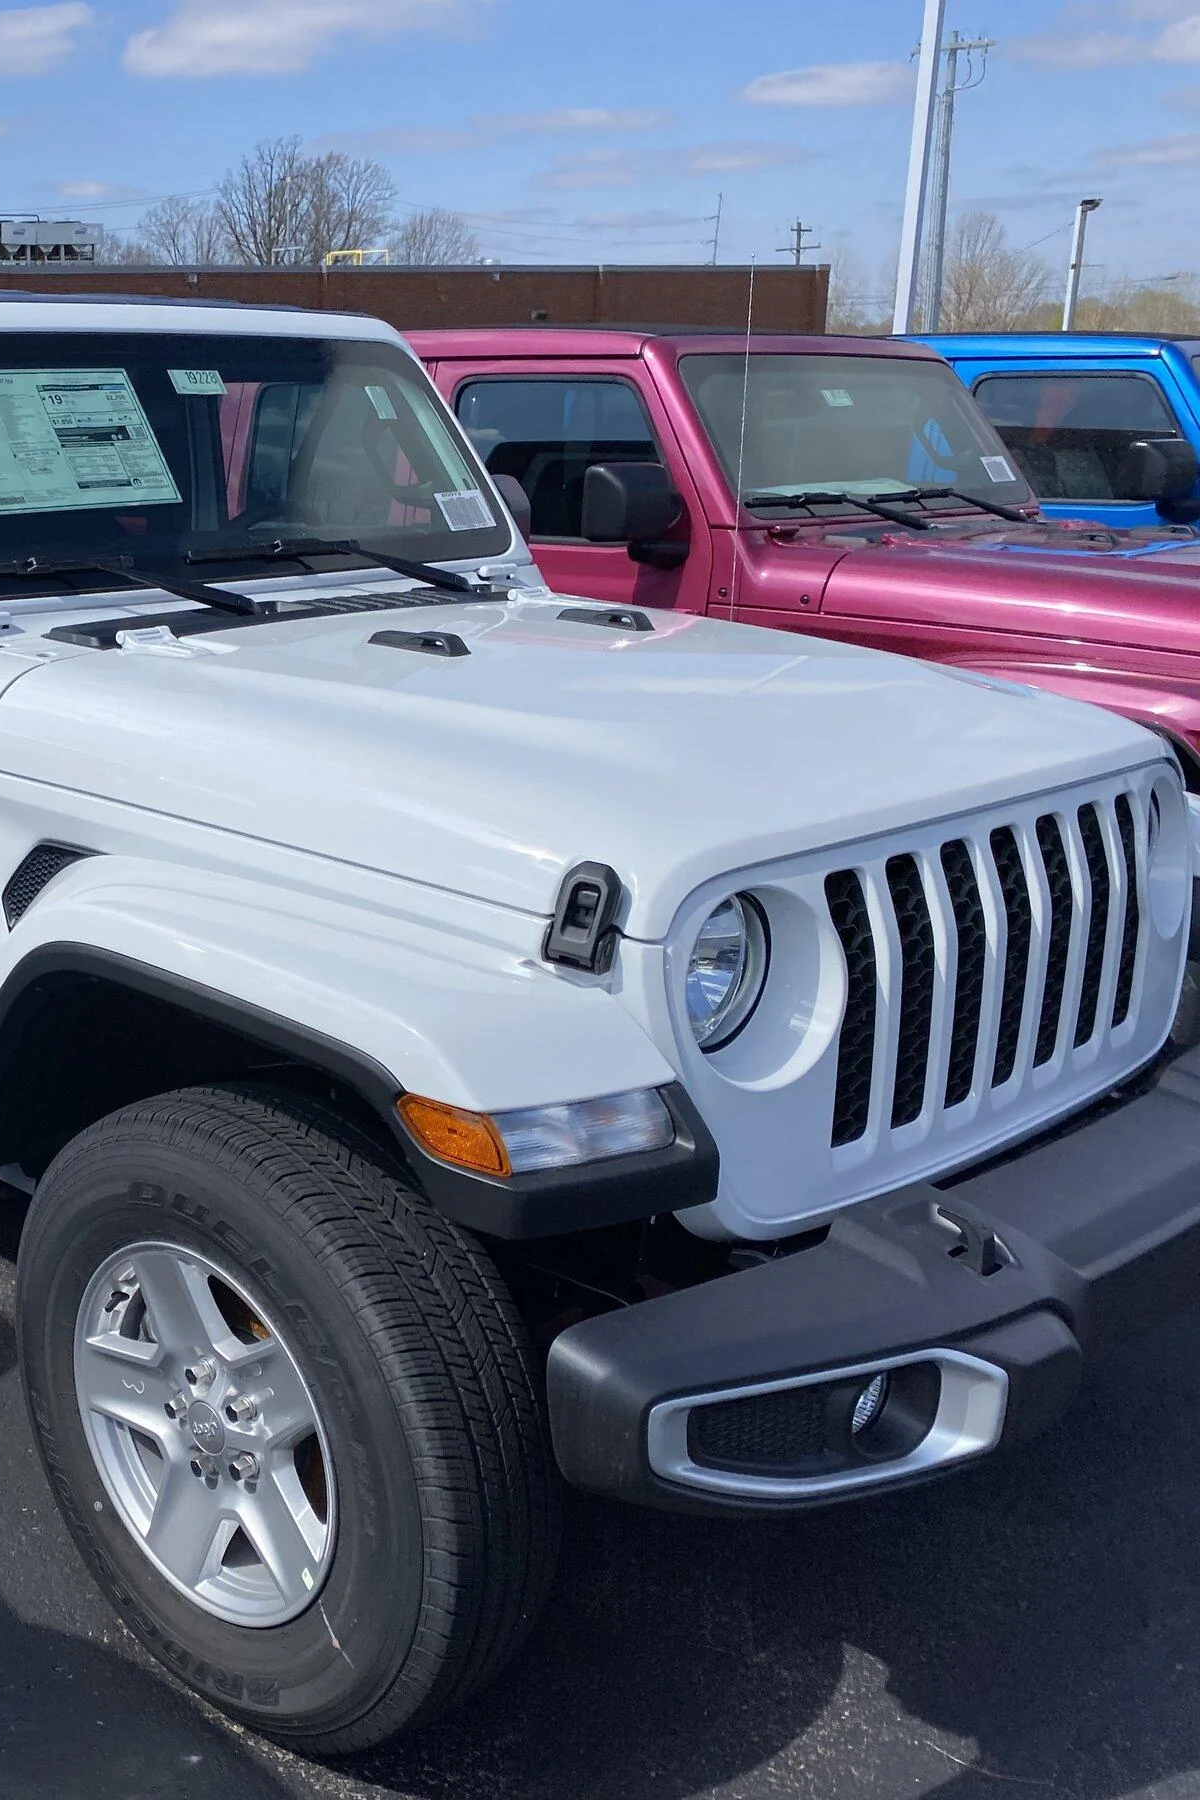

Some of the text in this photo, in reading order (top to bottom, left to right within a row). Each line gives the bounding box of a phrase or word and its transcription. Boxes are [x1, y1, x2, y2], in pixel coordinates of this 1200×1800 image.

[184, 371, 218, 384] 19228
[48, 394, 63, 405] 19
[192, 1420, 218, 1438] Jeep
